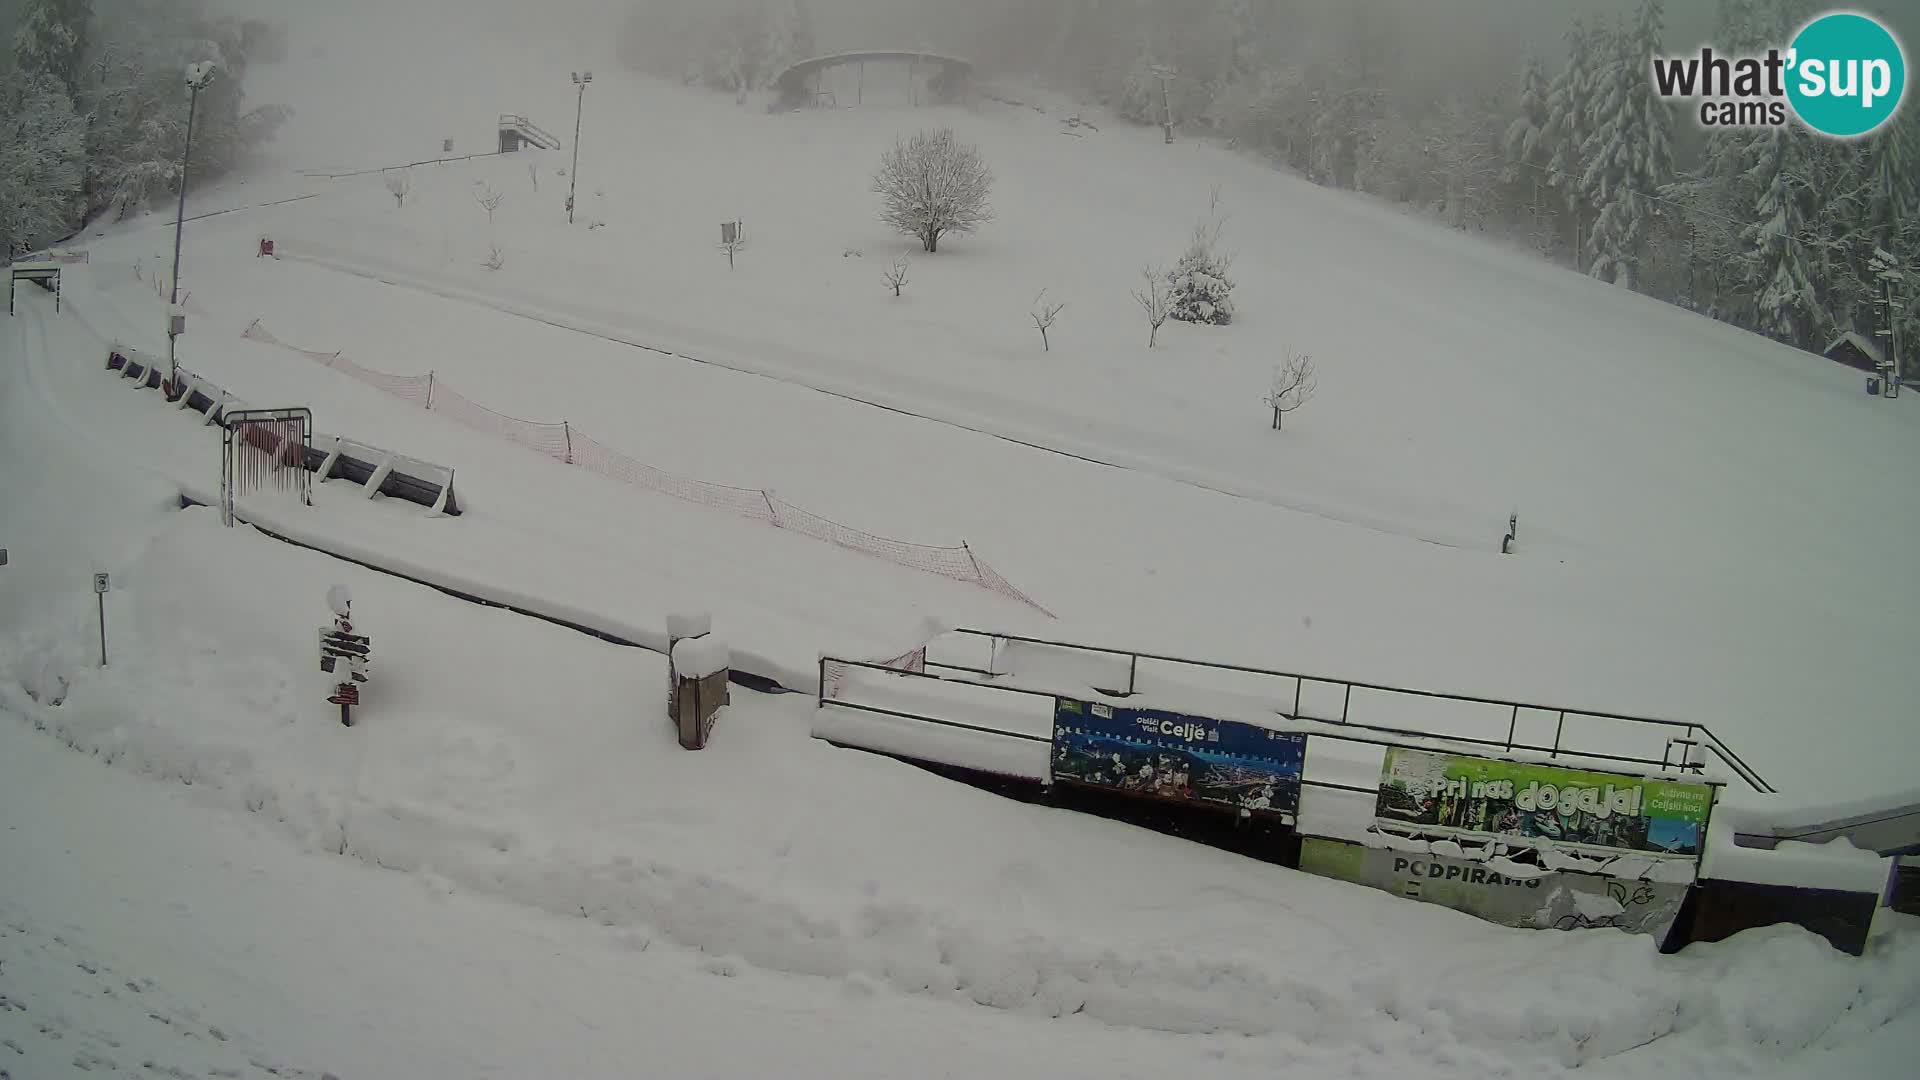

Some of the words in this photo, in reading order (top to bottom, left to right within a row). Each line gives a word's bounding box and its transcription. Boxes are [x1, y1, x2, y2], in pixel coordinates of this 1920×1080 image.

[1142, 725, 1158, 733] Visit
[1429, 775, 1467, 799] Pri
[1471, 778, 1514, 800] nas
[1515, 780, 1643, 819] dogaja!
